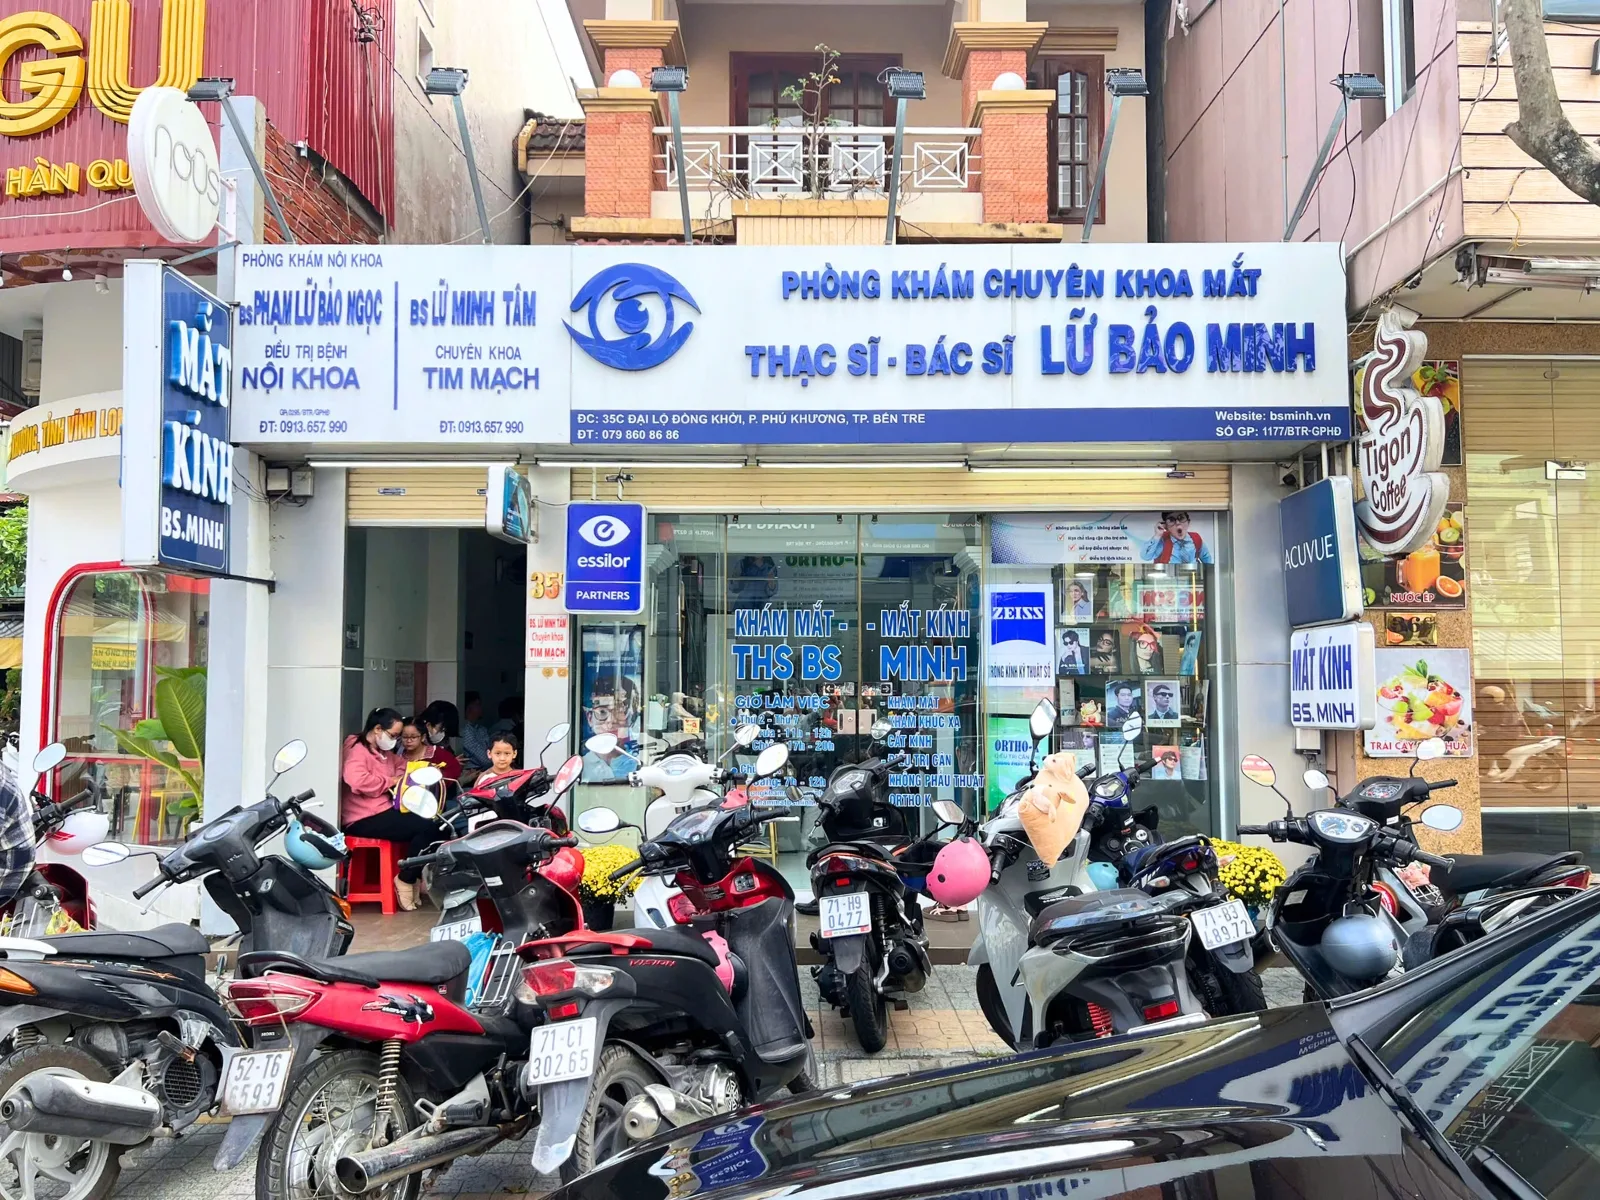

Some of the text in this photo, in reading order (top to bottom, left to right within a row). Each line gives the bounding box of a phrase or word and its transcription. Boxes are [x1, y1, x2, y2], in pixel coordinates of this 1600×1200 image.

[5, 156, 80, 197] HÀN
[243, 250, 283, 268] PHÒNG
[289, 250, 323, 268] KHÁM
[351, 253, 383, 268] KHOA
[782, 252, 1262, 300] PHÒNG KHÁM CHUYÊN KHOA MẮT
[239, 305, 253, 325] BS
[254, 290, 293, 334] PHẠM
[347, 289, 382, 335] NGỌC
[410, 299, 429, 326] BS
[452, 291, 495, 326] MINH
[503, 283, 536, 326] TÂM
[170, 302, 231, 408] MẮT
[265, 340, 347, 361] ĐIỀU TRỊ BỆNH
[436, 343, 522, 360] CHUYÊN KHOA
[745, 343, 836, 387] THẠC
[847, 336, 882, 377] SĨ
[905, 335, 972, 377] BÁC
[981, 335, 1016, 375] SĨ
[1040, 306, 1098, 375] LỮ
[1109, 304, 1195, 374] BẢO
[1206, 322, 1316, 374] MINH
[242, 361, 360, 394] NỘI KHOA
[423, 366, 539, 394] TIM MẠCH
[577, 413, 599, 424] ĐC:
[602, 413, 624, 424] 35C
[628, 413, 649, 427] ĐẠI
[749, 414, 758, 424] P.
[761, 412, 787, 424] PHÚ
[791, 413, 849, 425] KHƯƠNG,
[852, 413, 869, 424] TP.
[902, 413, 926, 424] TRE
[1215, 410, 1331, 420] Website: bsminh.vn
[42, 411, 65, 448] TỈNH
[67, 408, 96, 443] VĨNH
[260, 421, 277, 433] ĐT:
[440, 421, 456, 433] ĐT:
[577, 429, 680, 440] ĐT: 079 860 86 86
[1237, 426, 1259, 437] GP:
[166, 410, 233, 505] KÍNH
[1362, 427, 1411, 481] Tigon
[1371, 474, 1406, 512] Coffee
[162, 506, 224, 550] BS.MINH
[577, 553, 631, 568] essilor
[1284, 533, 1334, 571] ACUVUE
[531, 572, 564, 599] 35
[576, 591, 631, 600] PARTNERS
[1390, 590, 1435, 603] NƯỚC ÉP
[734, 600, 835, 638] KHÁM MẮT
[880, 600, 970, 638] MẮT KÍNH
[992, 606, 1044, 620] ZEISS
[530, 647, 566, 660] TIM MẠCH
[731, 644, 842, 681] THS BS
[880, 645, 967, 682] MINH
[1292, 633, 1352, 691] MẮT KÍNH
[735, 692, 831, 712] GIỜ LÀM VIỆC
[888, 692, 939, 709] KHÁM MẮT
[759, 714, 766, 724] 2
[793, 714, 799, 724] 7
[1292, 703, 1355, 724] BS. MINH
[812, 727, 832, 738] 12h
[909, 732, 932, 748] KÍNH
[888, 771, 921, 787] KHÔNG
[888, 793, 932, 807] ORTHO K
[827, 896, 862, 914] 71-H9
[1200, 905, 1239, 926] 71-B3
[828, 910, 862, 928] 0477
[440, 922, 473, 941] 71-B4
[540, 1026, 583, 1053] 71-C1
[235, 1054, 283, 1082] 52-T6
[533, 1049, 589, 1079] 302.65
